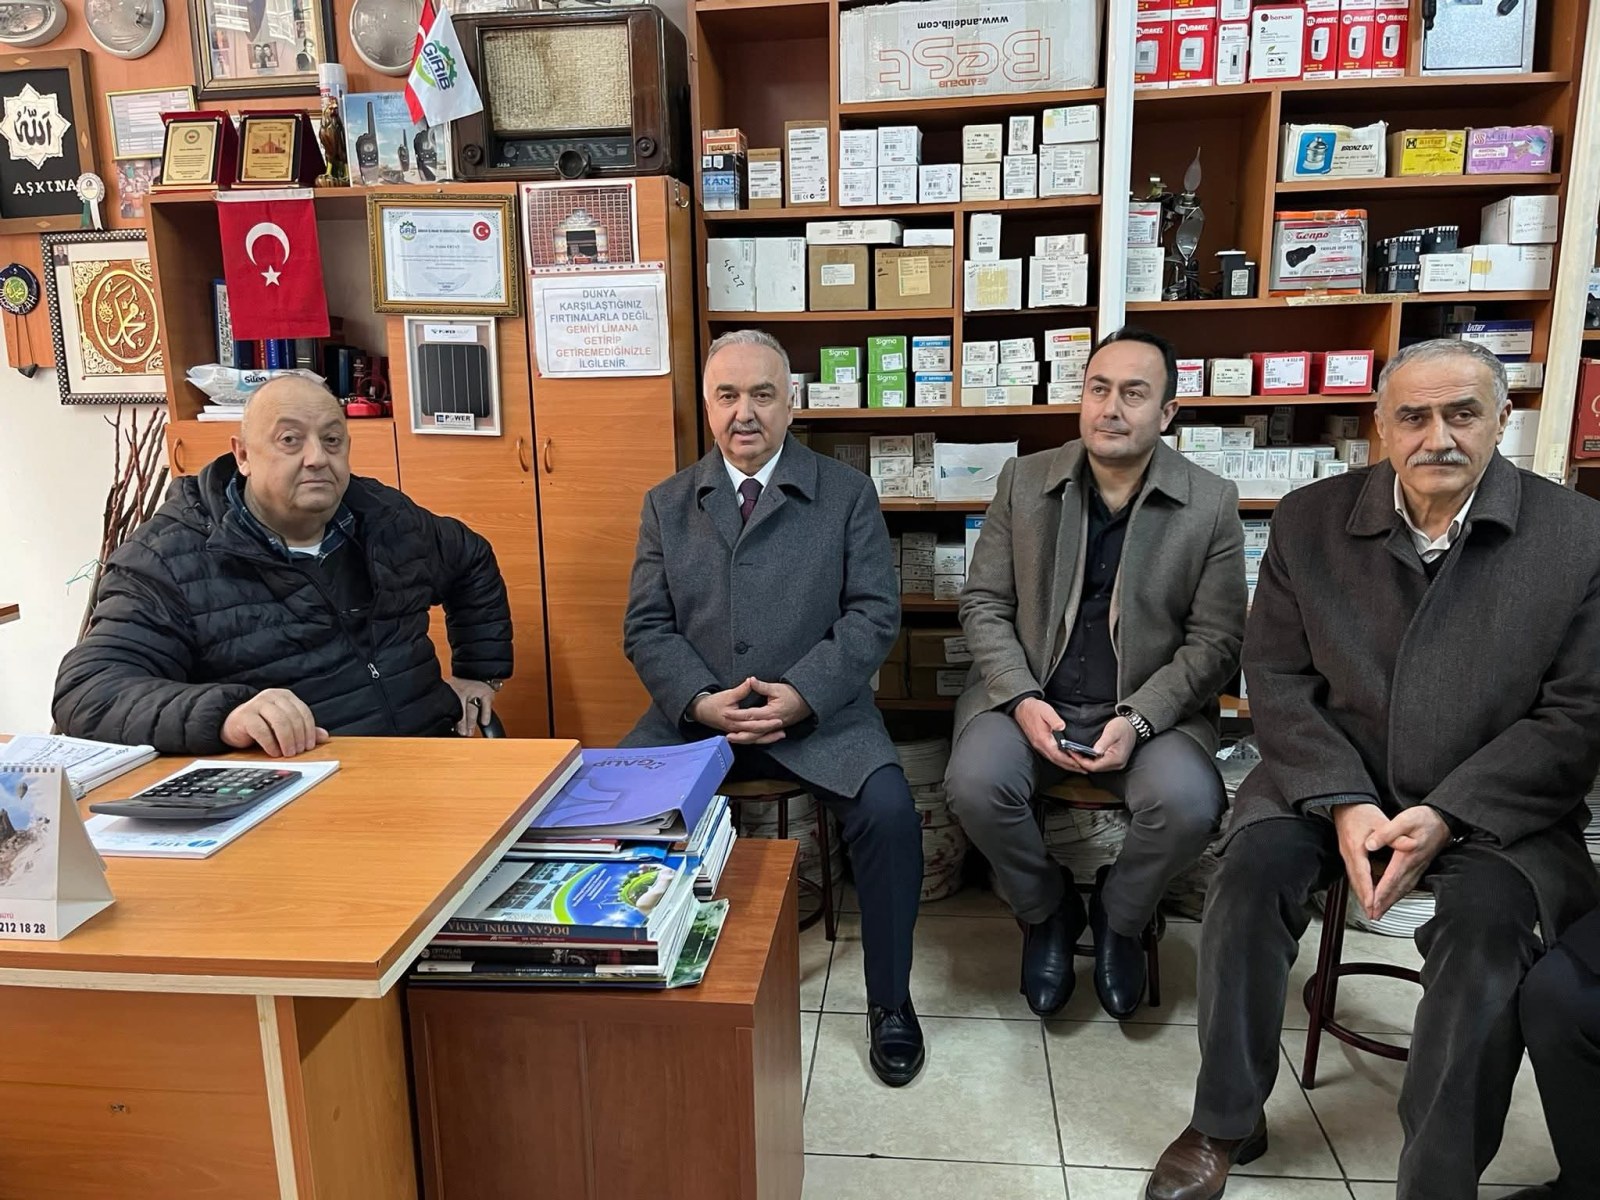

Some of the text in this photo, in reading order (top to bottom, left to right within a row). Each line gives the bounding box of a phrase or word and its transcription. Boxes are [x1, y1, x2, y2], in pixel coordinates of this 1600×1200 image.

[917, 15, 1009, 30] www.andelib.com
[1187, 24, 1209, 32] MAKEL
[879, 29, 1051, 91] Best
[582, 287, 617, 299] DÜNYA
[559, 300, 642, 311] KARŞILAŞTIĞINIZ
[550, 313, 619, 323] FIRTINALARLA
[566, 322, 639, 334] GEMİYİ LİMANA
[584, 335, 622, 345] GETİRİP
[875, 338, 897, 346] Sigma
[555, 346, 652, 358] GETİREMEDİĞİNİZLE
[828, 349, 849, 357] Sigma
[20, 923, 31, 933] 18
[33, 923, 46, 934] 28
[448, 921, 570, 936] DOĞAN AYDINLATMA
